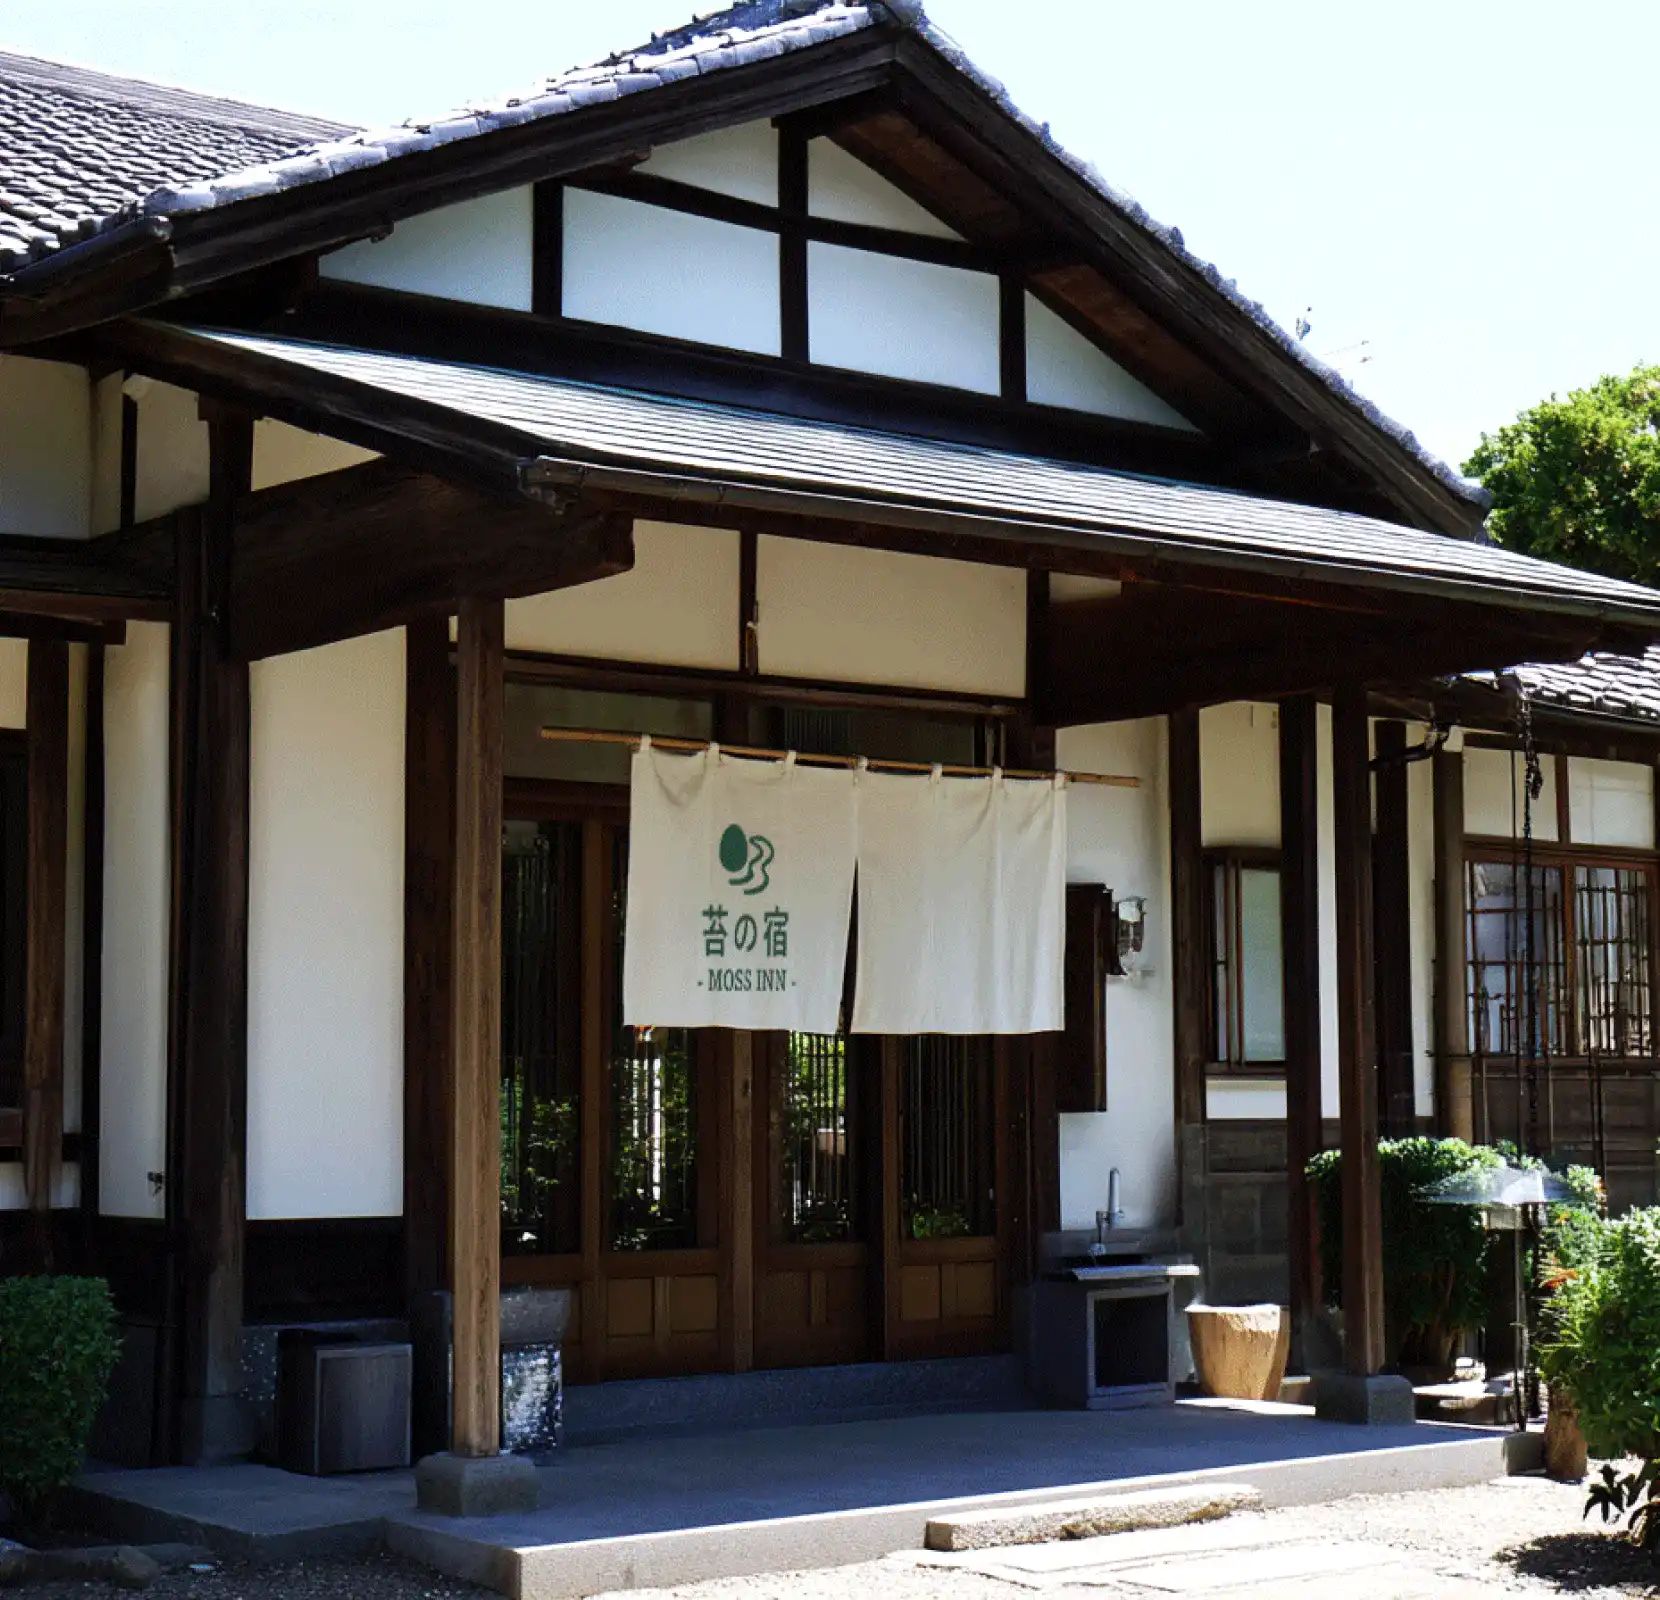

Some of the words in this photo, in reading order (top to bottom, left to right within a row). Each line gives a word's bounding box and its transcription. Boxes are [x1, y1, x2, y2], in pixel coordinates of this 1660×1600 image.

[702, 904, 789, 957] 苔の宿
[708, 968, 752, 992] MOSS
[756, 968, 787, 992] INN
